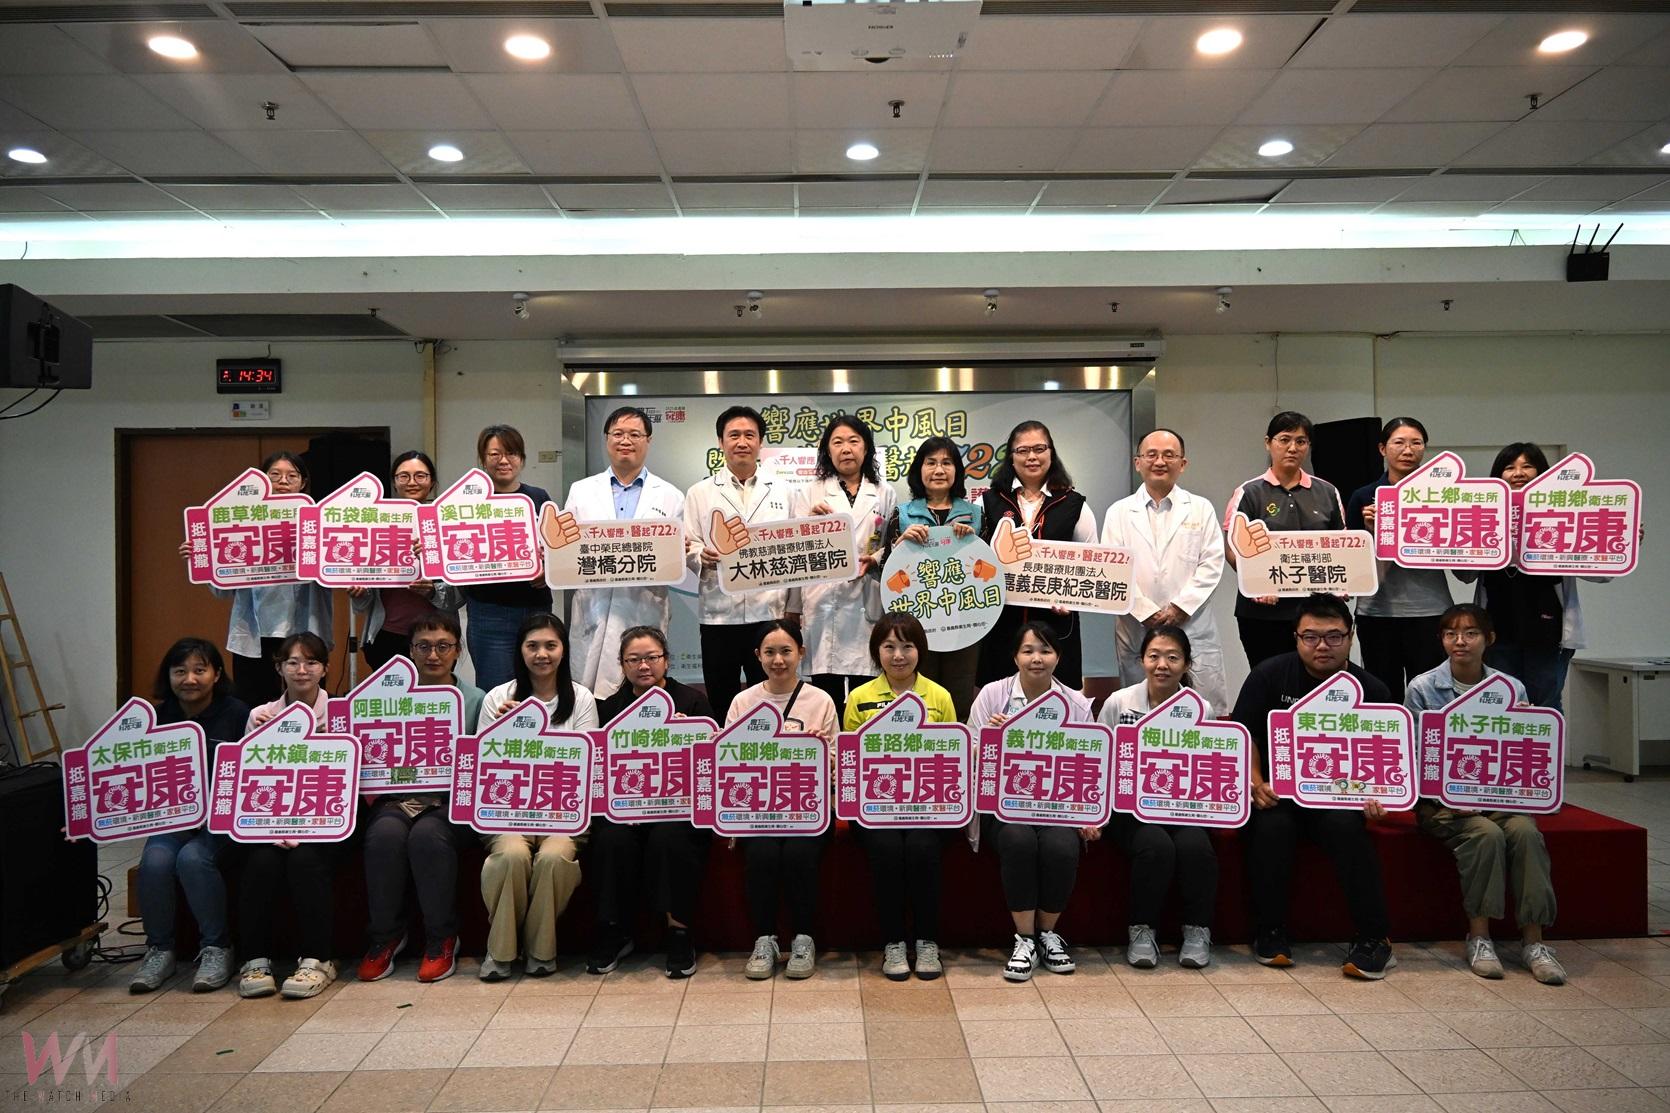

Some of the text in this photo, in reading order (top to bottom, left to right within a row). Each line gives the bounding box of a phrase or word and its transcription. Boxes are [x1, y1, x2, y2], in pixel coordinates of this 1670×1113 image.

[239, 370, 272, 382] 14:34
[1402, 487, 1498, 504] 水上鄉衛生所
[1528, 490, 1628, 507] 中埔鄉衛生所
[324, 507, 413, 523] 布袋鎮衛生所
[441, 503, 524, 521] 溪口鄉衛生所
[1401, 505, 1502, 548] 安康
[1525, 508, 1629, 553] 安康
[323, 525, 416, 566] 安康
[442, 520, 532, 563] 安康
[579, 542, 653, 554] 臺中榮民總醫院
[739, 538, 834, 559] 佛教慈濟醫療財團法人
[577, 554, 657, 576] 灣橋分院
[729, 549, 848, 582] 大林慈濟醫院
[1022, 562, 1107, 579] 長庚醫療財團法人
[1280, 553, 1332, 564] 衛生福利部
[917, 557, 966, 589] 響應
[1269, 565, 1347, 584] 朴子醫院
[1004, 572, 1128, 601] 嘉義長庚紀念醫院
[354, 697, 451, 718] 阿里山鄉衛生所
[1297, 712, 1400, 733] 東石鄉衛生所
[1449, 713, 1551, 737] 朴子市衛生所
[353, 717, 453, 768] 安康
[482, 738, 582, 759] 大埔鄉衛生所
[864, 733, 960, 753] 番路鄉衛生所
[1006, 728, 1102, 752] 義竹鄉衛生所
[1142, 726, 1238, 751] 梅山鄉衛生所
[92, 738, 192, 766] 太保市衛生所
[245, 744, 348, 764] 大林鎮衛生所
[1297, 733, 1406, 785] 安康
[1447, 735, 1553, 788] 安康
[92, 755, 199, 813] 安康
[480, 760, 583, 810] 安康
[718, 762, 821, 812] 安康
[862, 754, 963, 803] 安康
[1003, 751, 1104, 803] 安康
[1140, 749, 1242, 802] 安康
[241, 765, 348, 816] 安康
